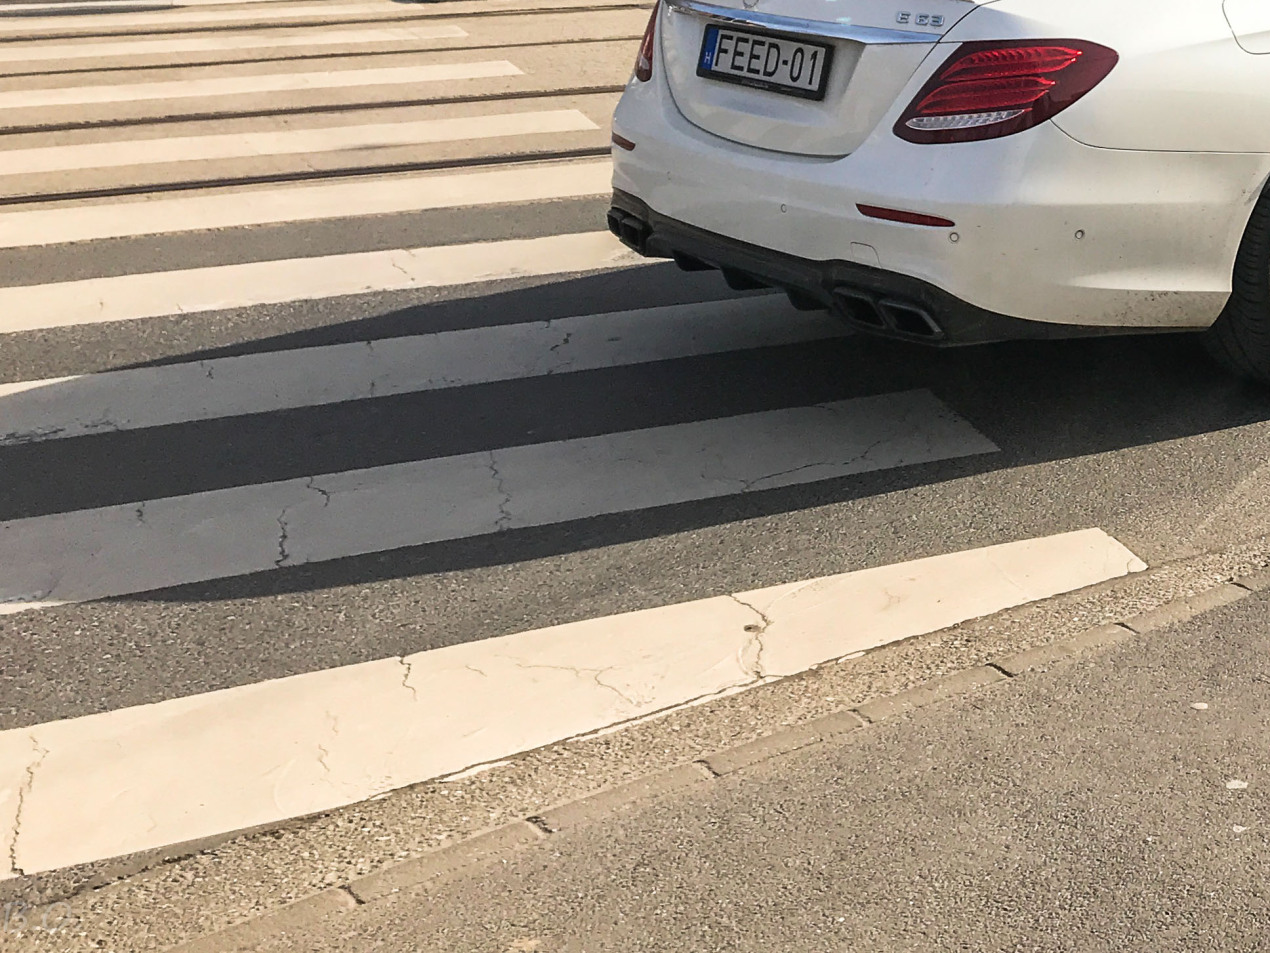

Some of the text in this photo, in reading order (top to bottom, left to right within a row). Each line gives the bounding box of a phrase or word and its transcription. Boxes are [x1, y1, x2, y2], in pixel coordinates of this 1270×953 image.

[896, 11, 945, 27] E 63
[715, 34, 819, 86] FEED-01
